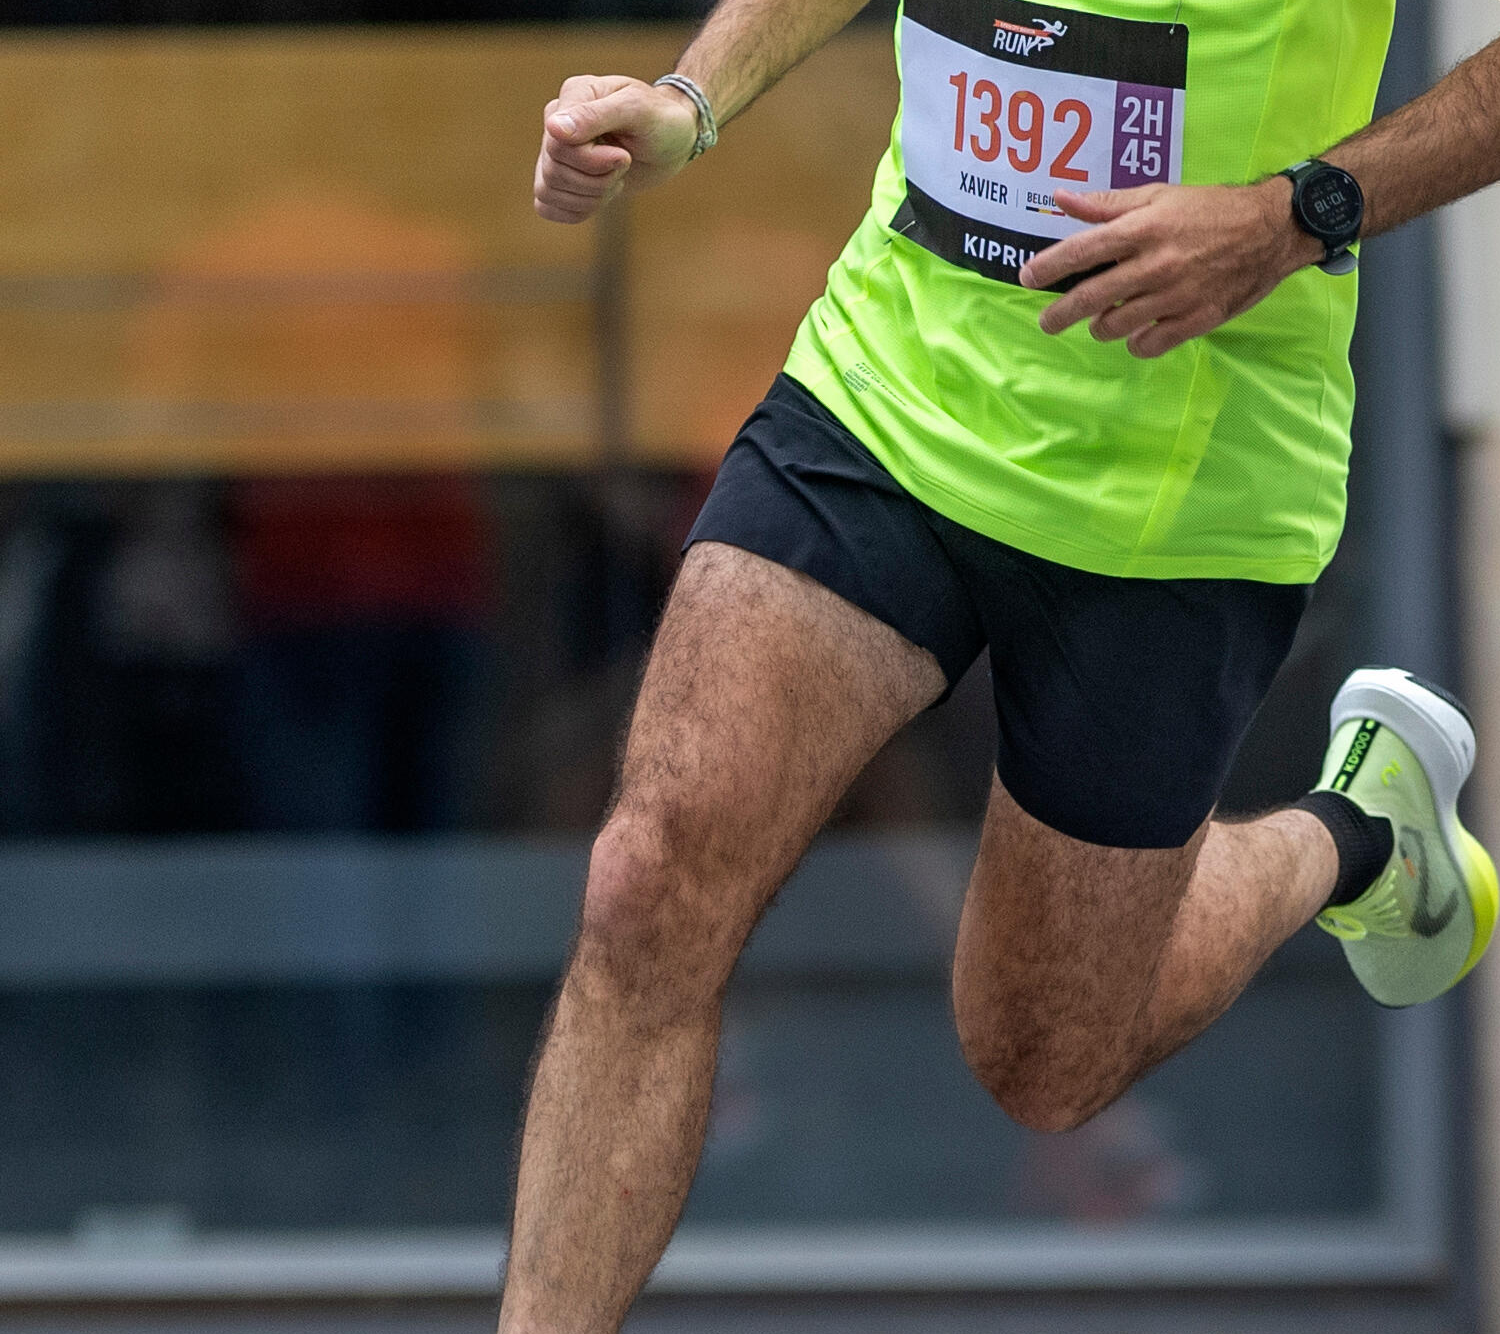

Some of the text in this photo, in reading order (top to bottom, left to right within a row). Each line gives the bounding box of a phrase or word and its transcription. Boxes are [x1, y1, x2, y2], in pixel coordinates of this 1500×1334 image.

[993, 28, 1032, 57] RUN
[949, 71, 1093, 182] 1392
[1120, 96, 1164, 137] 2H
[1119, 138, 1162, 178] 45
[959, 171, 1008, 205] XAVIER
[964, 233, 1035, 268] KIPRU
[1343, 731, 1370, 773] KD900
